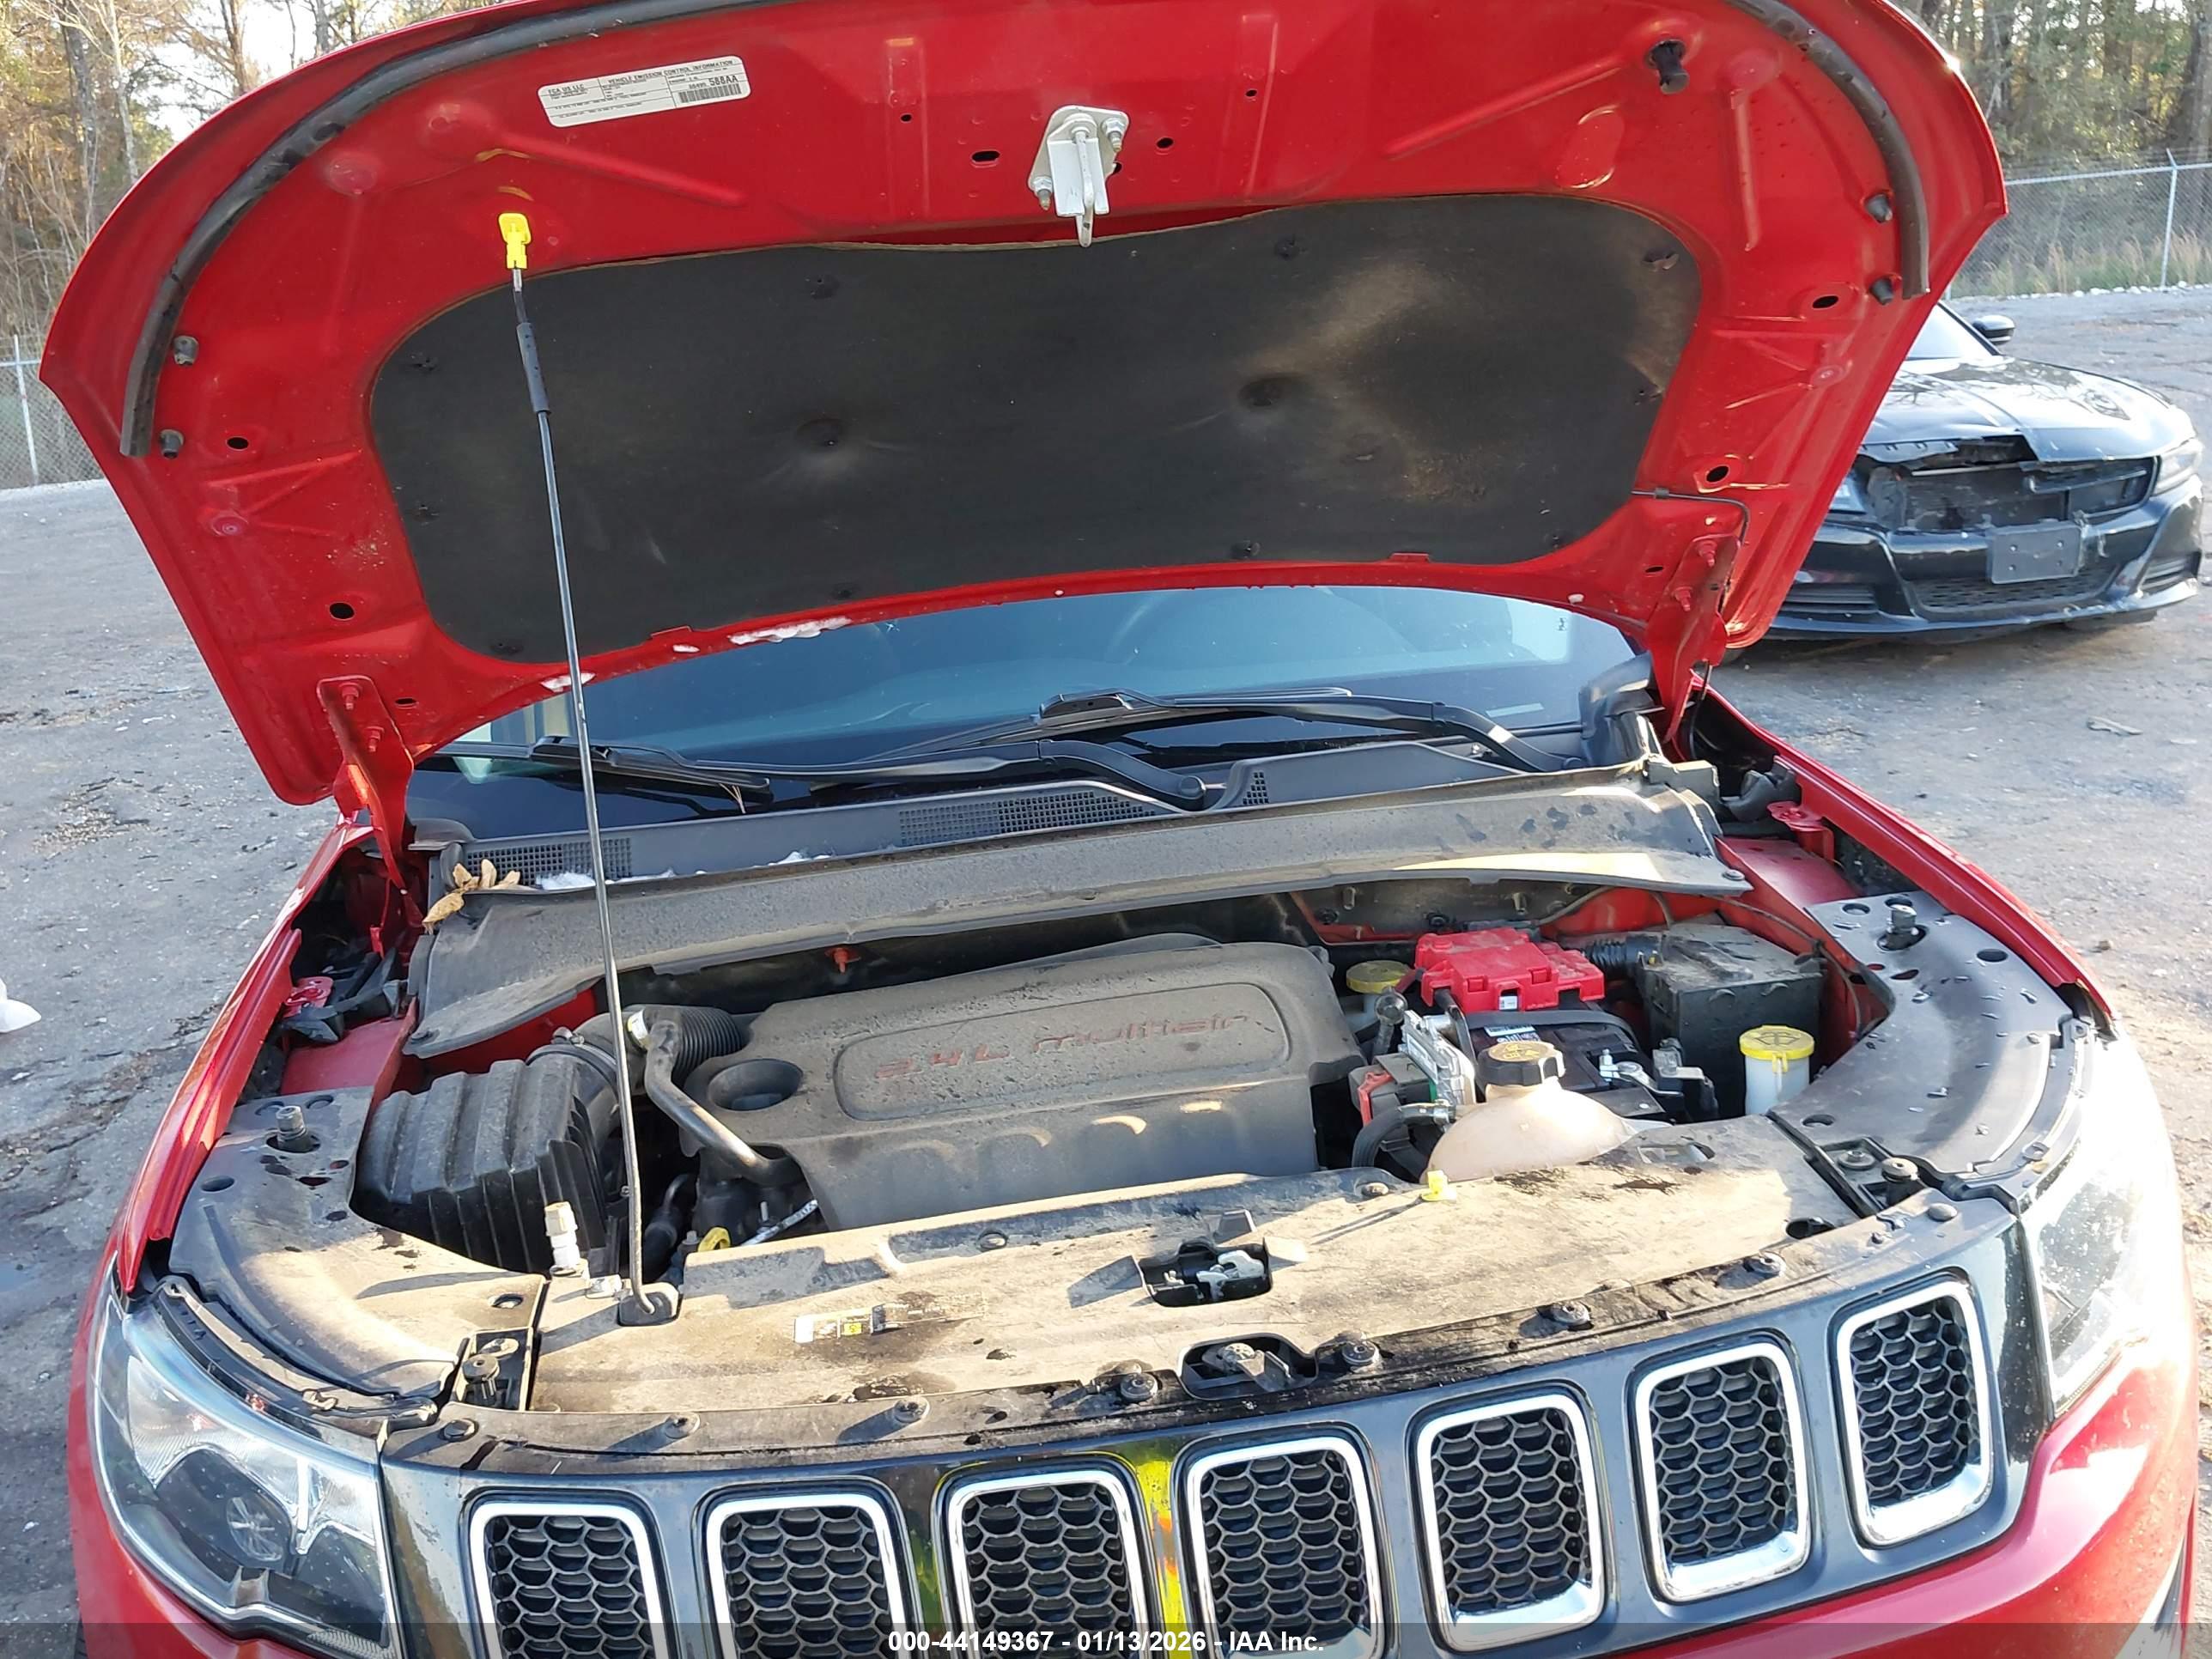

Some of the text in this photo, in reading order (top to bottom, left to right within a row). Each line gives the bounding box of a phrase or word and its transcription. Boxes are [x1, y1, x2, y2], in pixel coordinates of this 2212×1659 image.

[607, 76, 633, 85] VEHICLE
[634, 70, 663, 82] EMISSION
[663, 66, 691, 76] CONTROL
[692, 60, 733, 71] INFORMATION
[708, 75, 738, 86] 588AA
